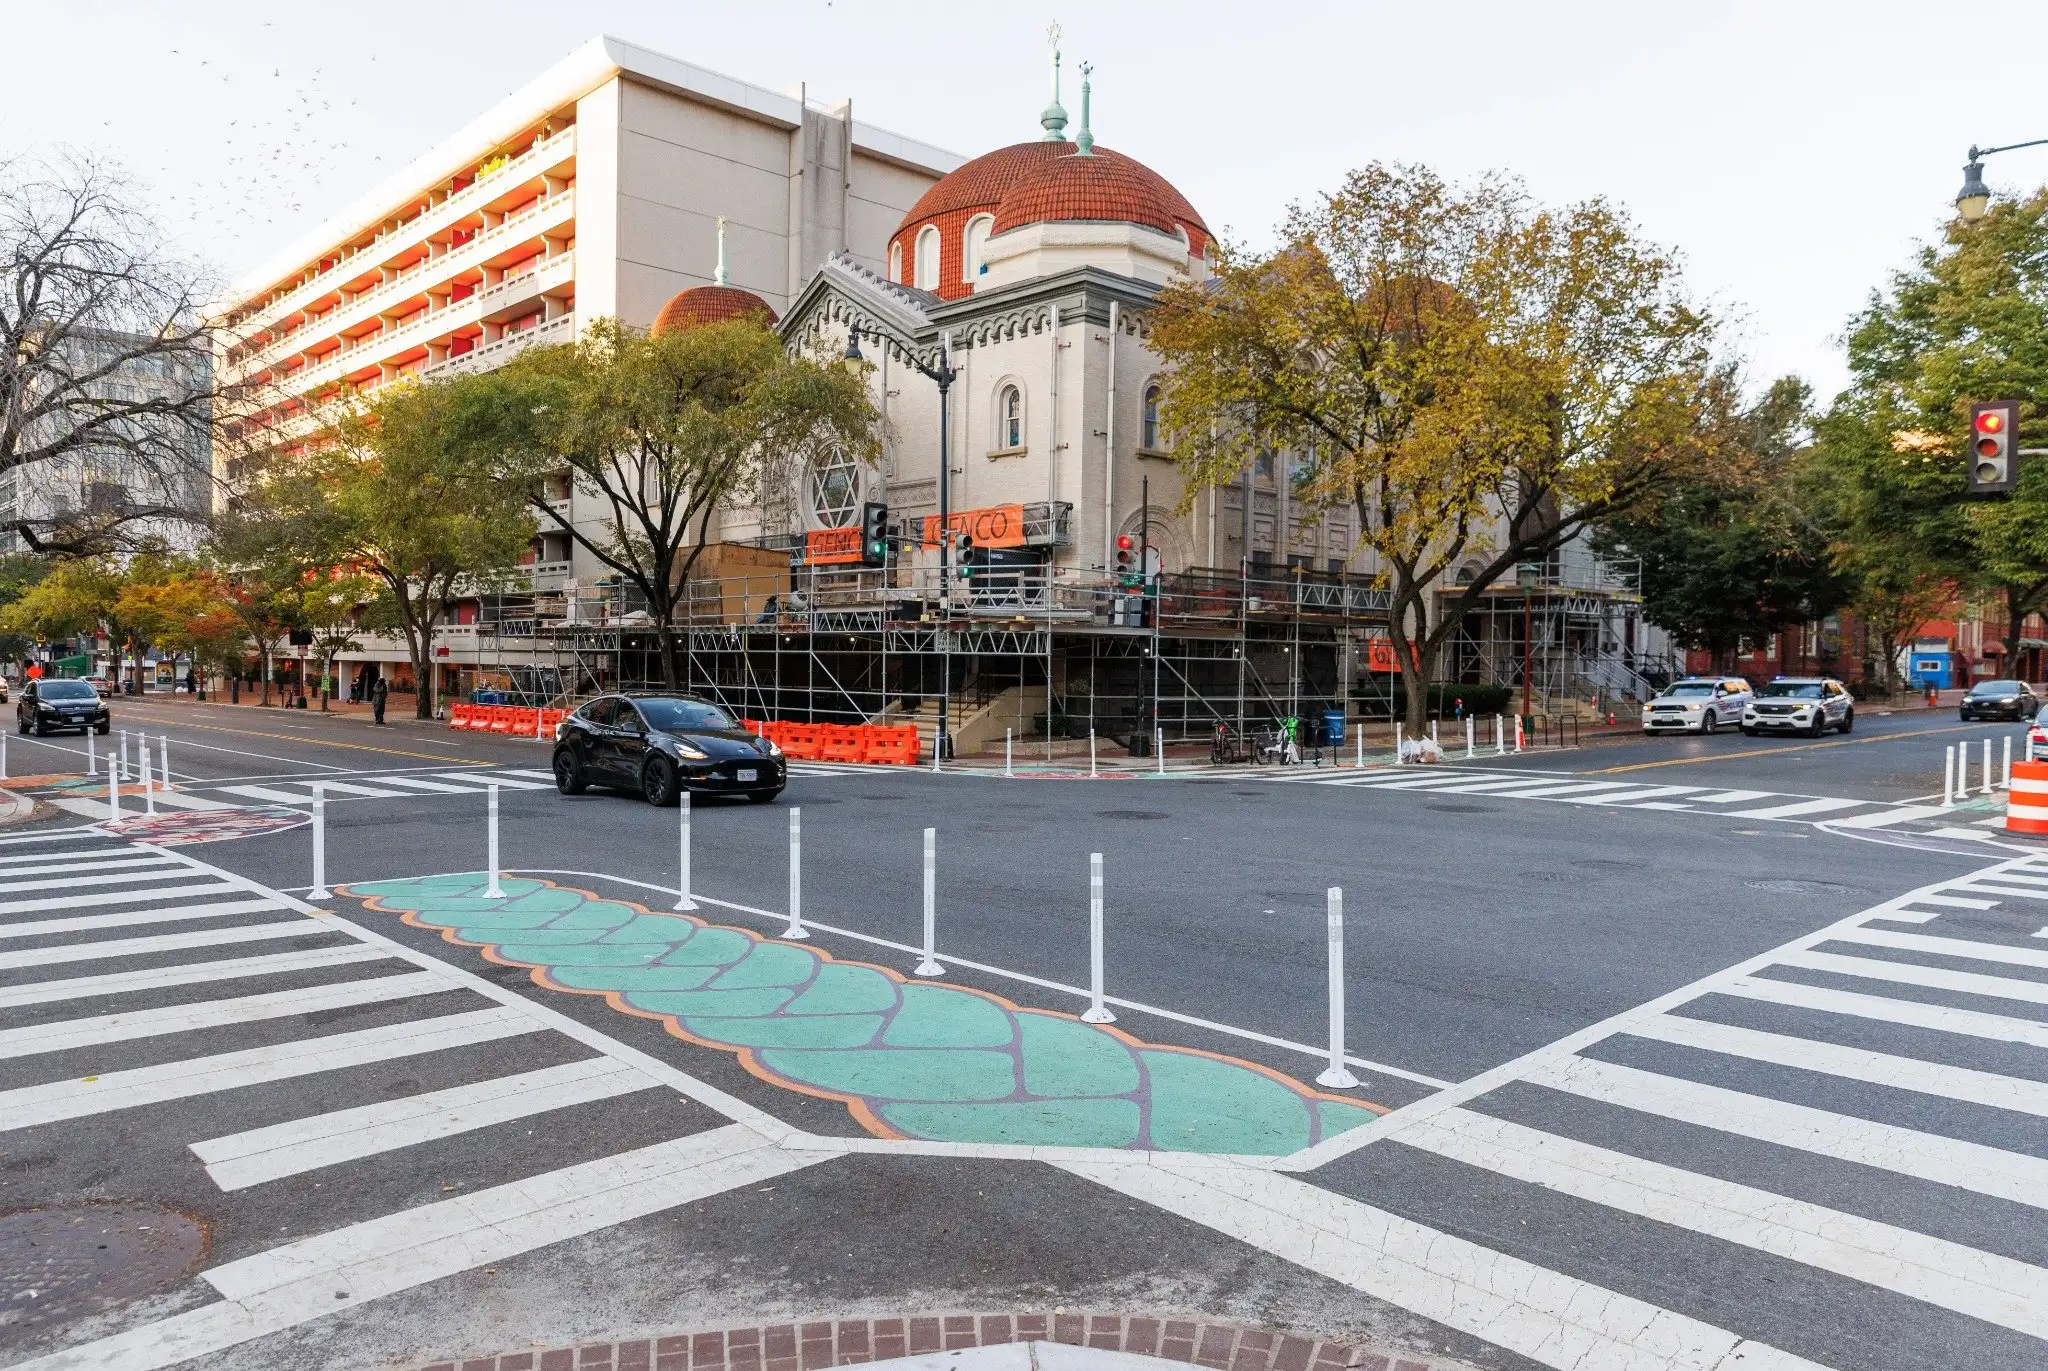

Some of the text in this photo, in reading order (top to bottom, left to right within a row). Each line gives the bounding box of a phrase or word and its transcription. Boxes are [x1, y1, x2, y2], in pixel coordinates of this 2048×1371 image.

[932, 511, 1008, 544] GENCO
[814, 531, 862, 555] GENC
[1726, 701, 1745, 709] POLICE
